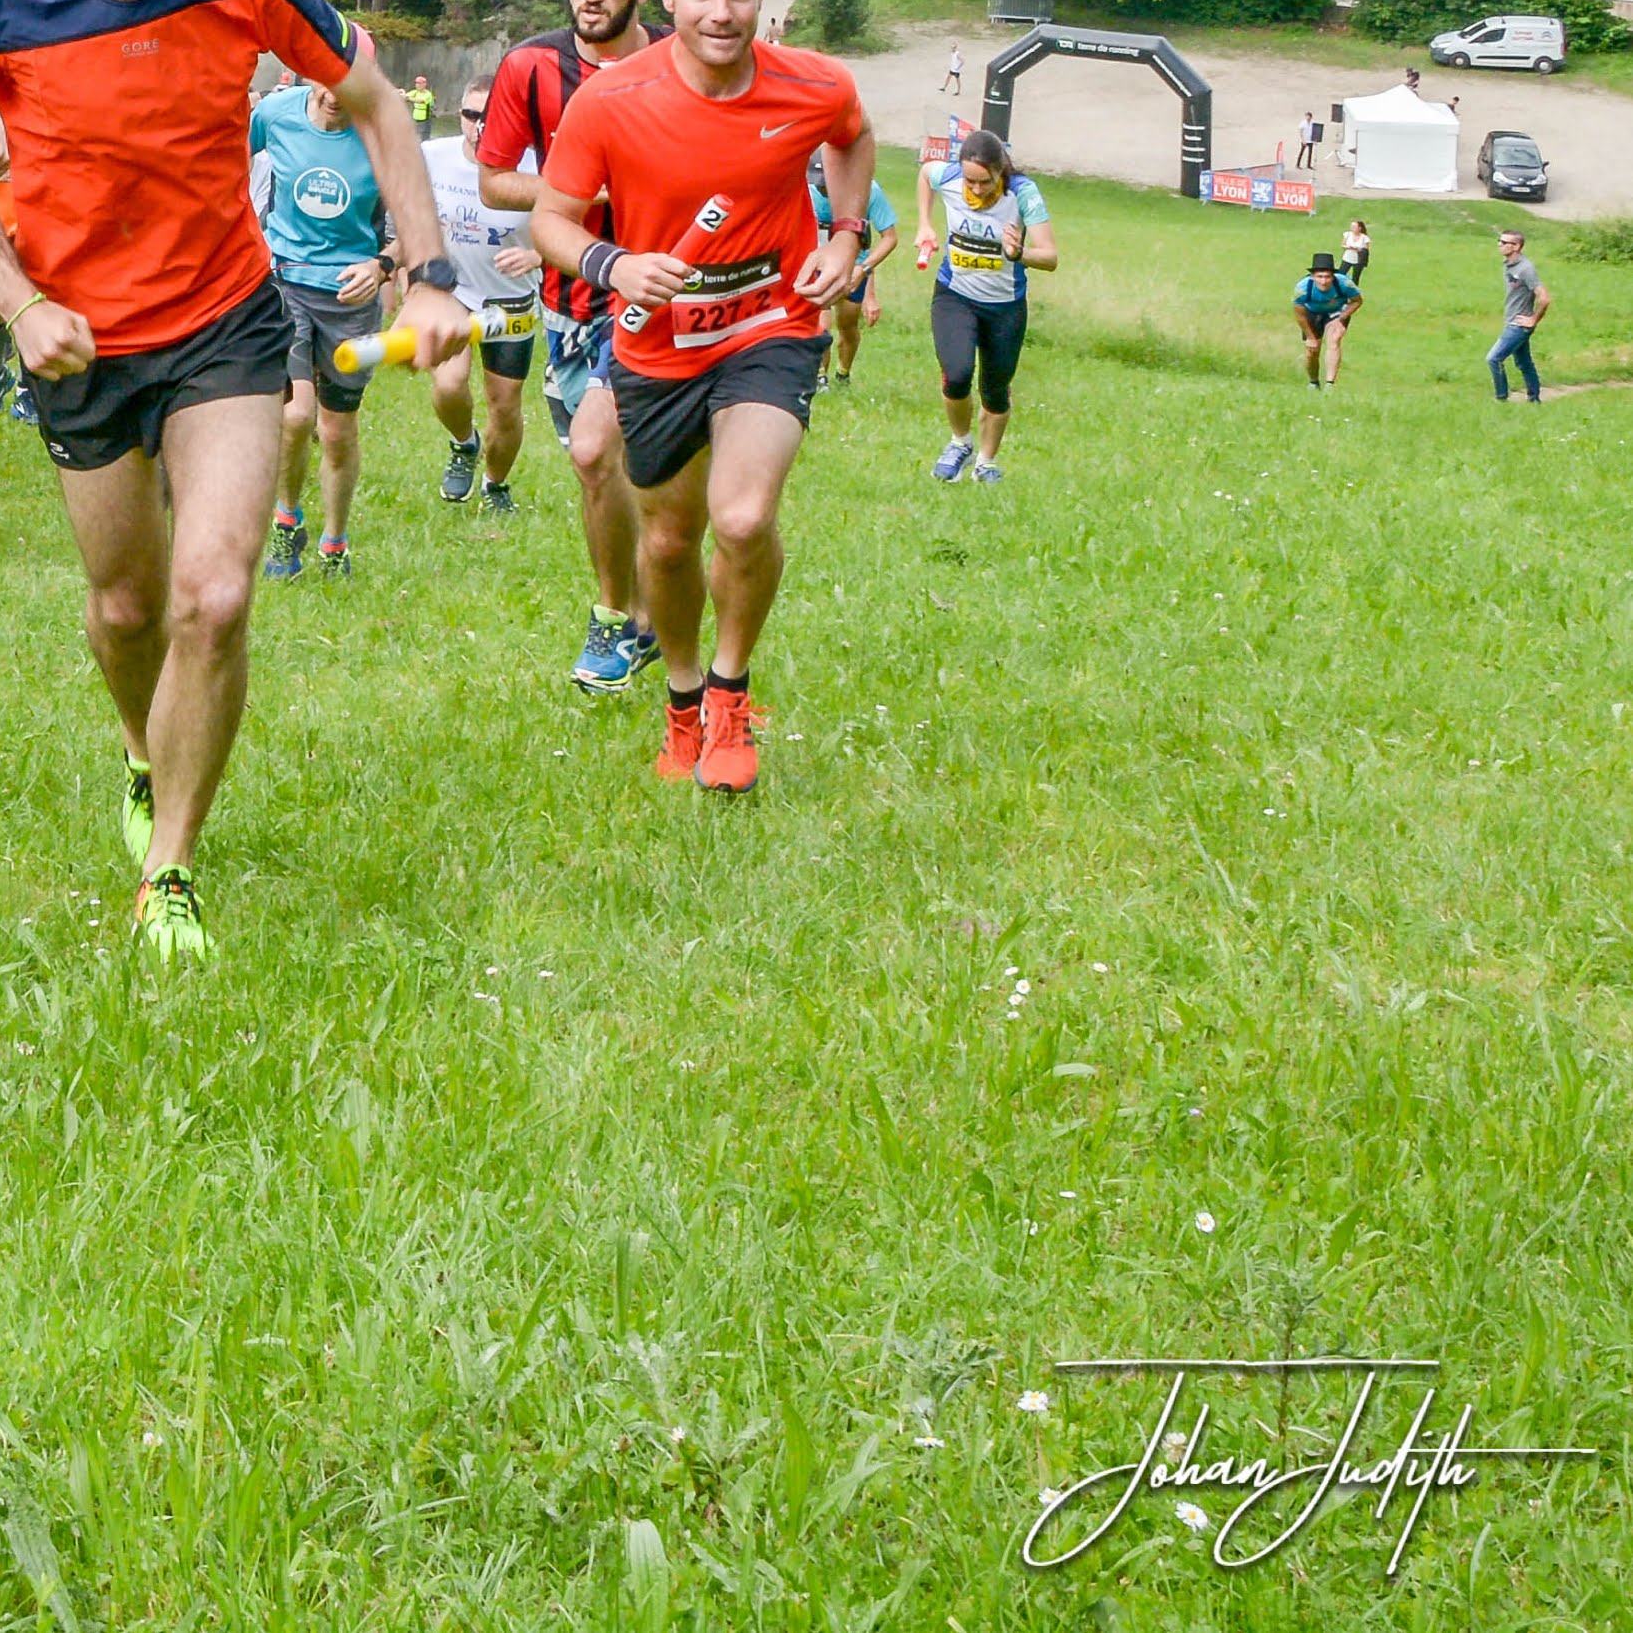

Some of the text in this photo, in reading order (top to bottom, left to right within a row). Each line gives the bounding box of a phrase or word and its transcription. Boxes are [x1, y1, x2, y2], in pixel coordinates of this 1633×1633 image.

[121, 38, 159, 53] GORE
[1214, 184, 1248, 200] LYON
[1276, 192, 1309, 207] LYON
[702, 209, 721, 229] 2
[952, 253, 996, 270] 354.3
[704, 273, 727, 284] terre
[688, 289, 771, 333] 227.2
